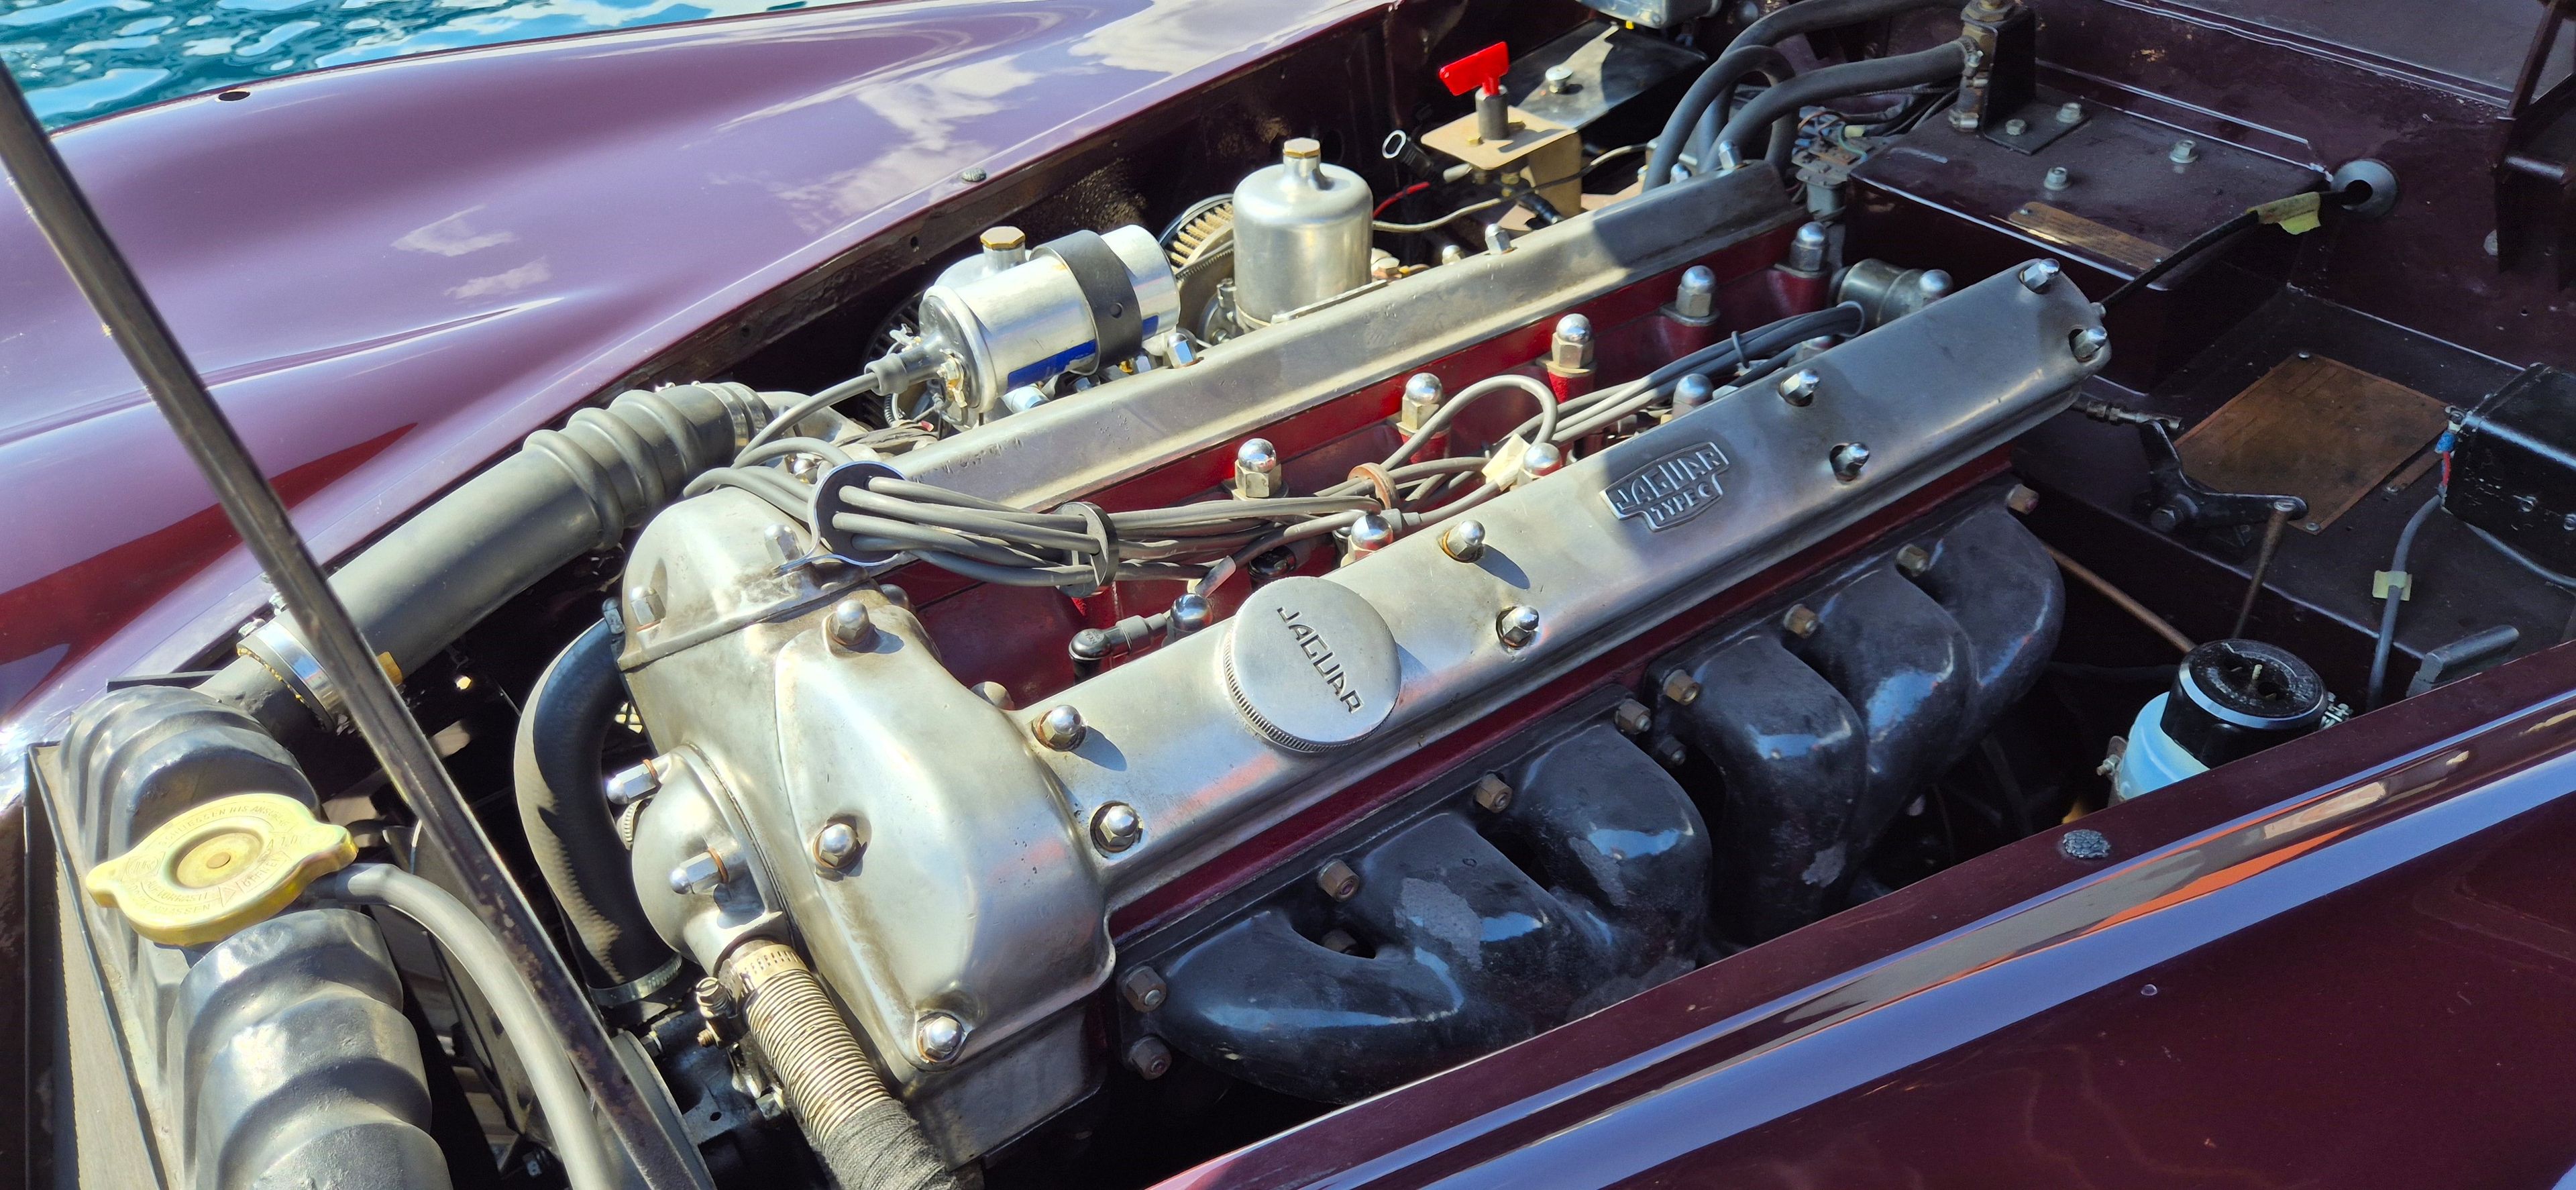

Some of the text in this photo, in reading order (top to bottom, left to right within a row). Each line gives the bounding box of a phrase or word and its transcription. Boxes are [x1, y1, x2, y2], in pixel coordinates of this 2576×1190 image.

[1615, 451, 1722, 511] JAGUAR
[1650, 482, 1711, 522] TYPE C
[1276, 606, 1365, 714] JAGUAR
